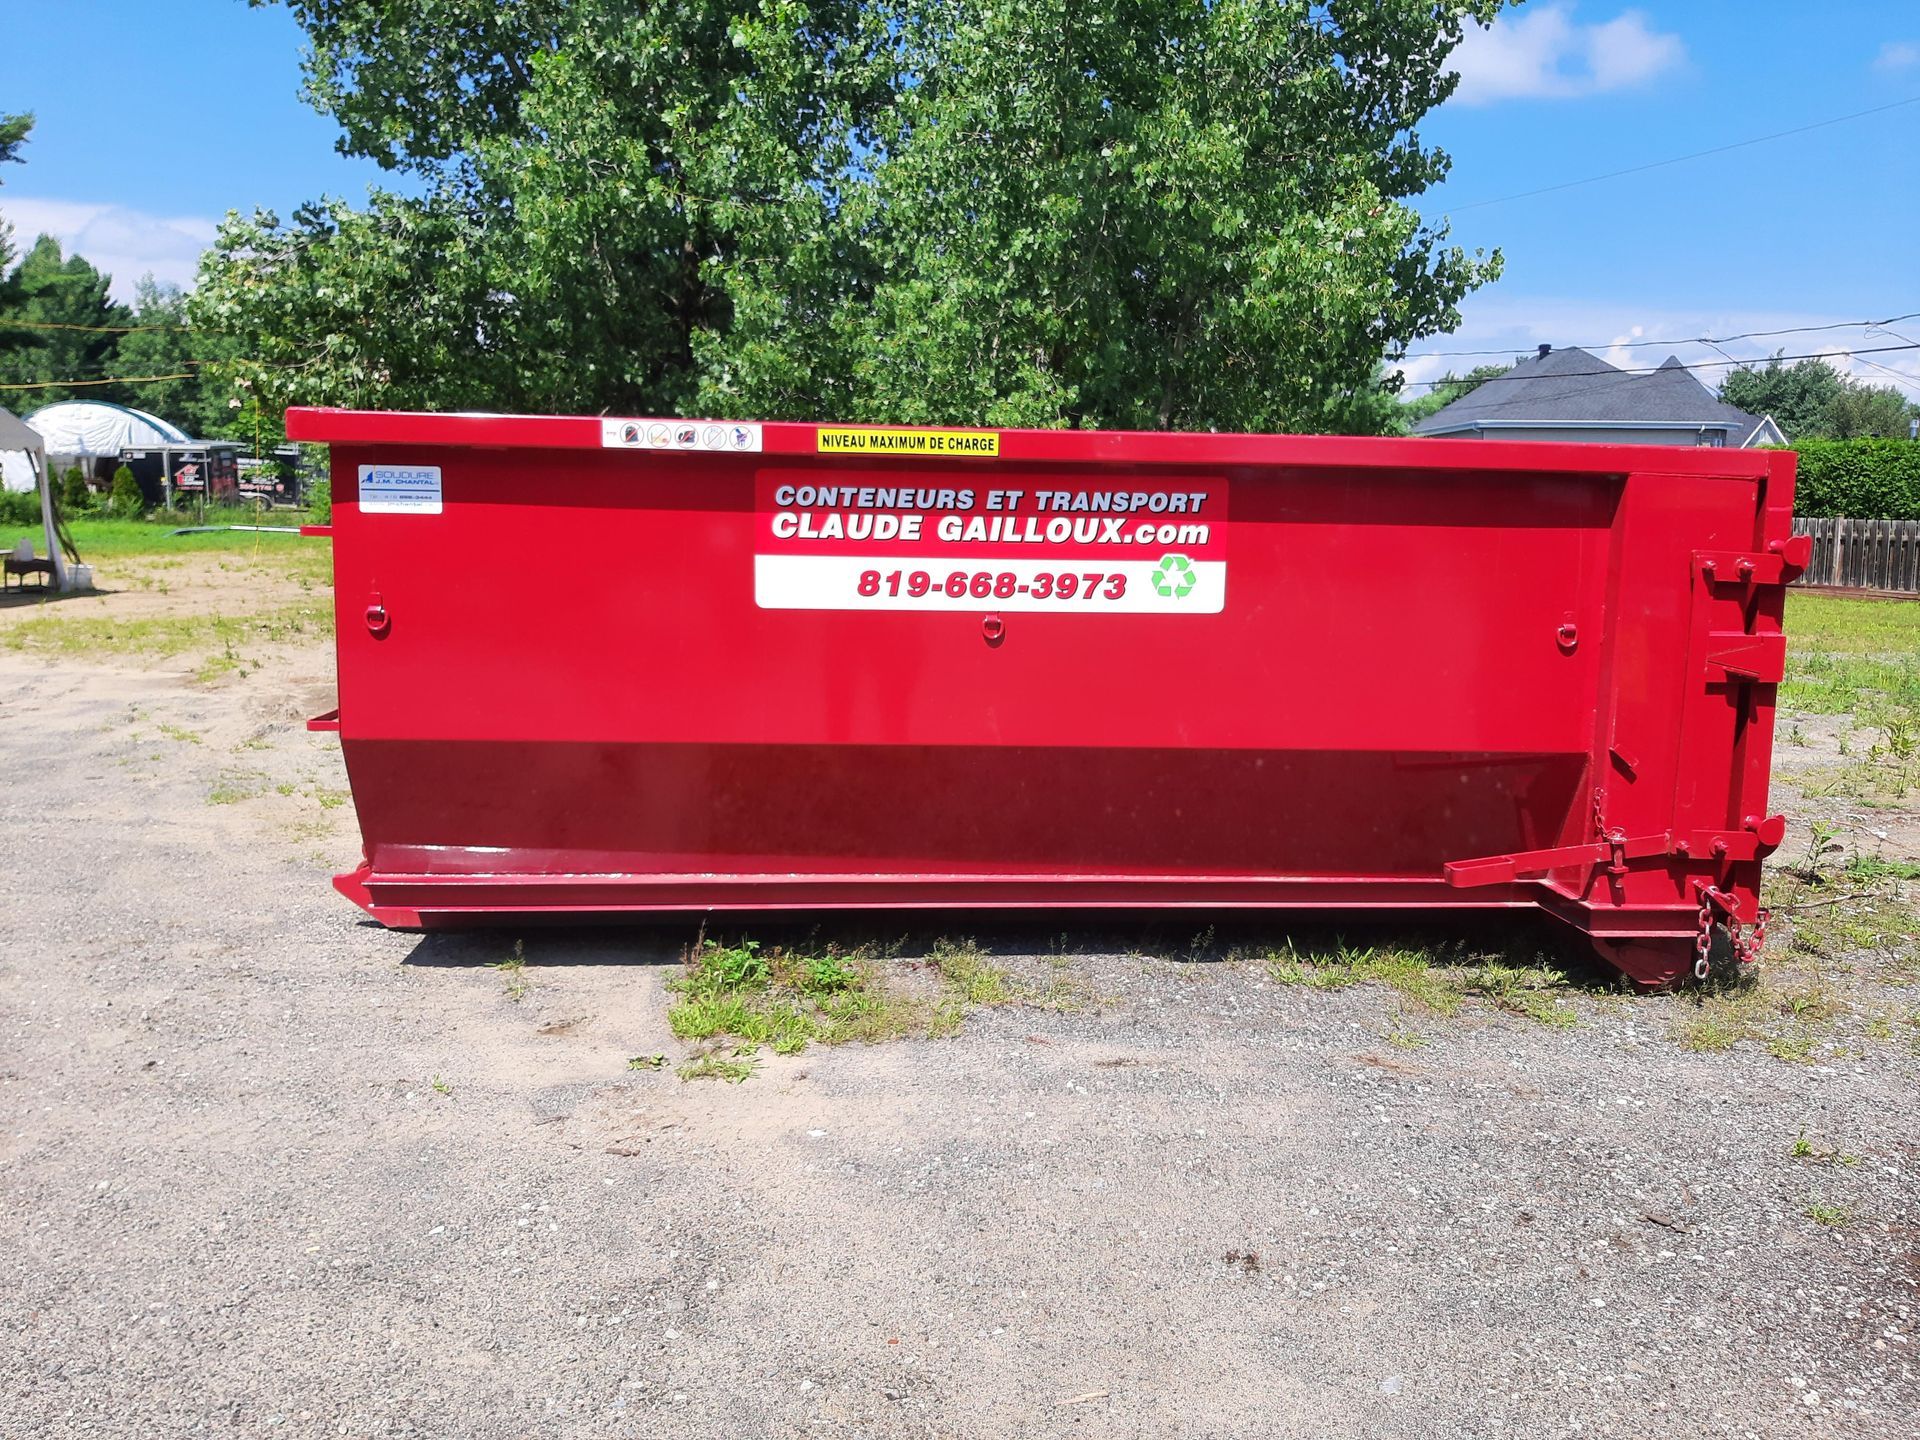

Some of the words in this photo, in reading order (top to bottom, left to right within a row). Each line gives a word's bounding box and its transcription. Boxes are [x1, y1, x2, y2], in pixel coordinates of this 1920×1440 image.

[822, 434, 866, 448] NIVEAU
[870, 435, 926, 449] MAXIMUM
[929, 437, 944, 450] DE
[948, 437, 995, 451] CHARGE
[375, 471, 434, 479] SOUDURE
[775, 485, 975, 510] CONTENEURS
[986, 489, 1025, 511] ET
[1035, 491, 1208, 514] TRANSPORT
[771, 511, 923, 542] CLAUDE
[937, 515, 1210, 545] GAILLOUX.com
[857, 570, 1128, 600] 819-668-3973
